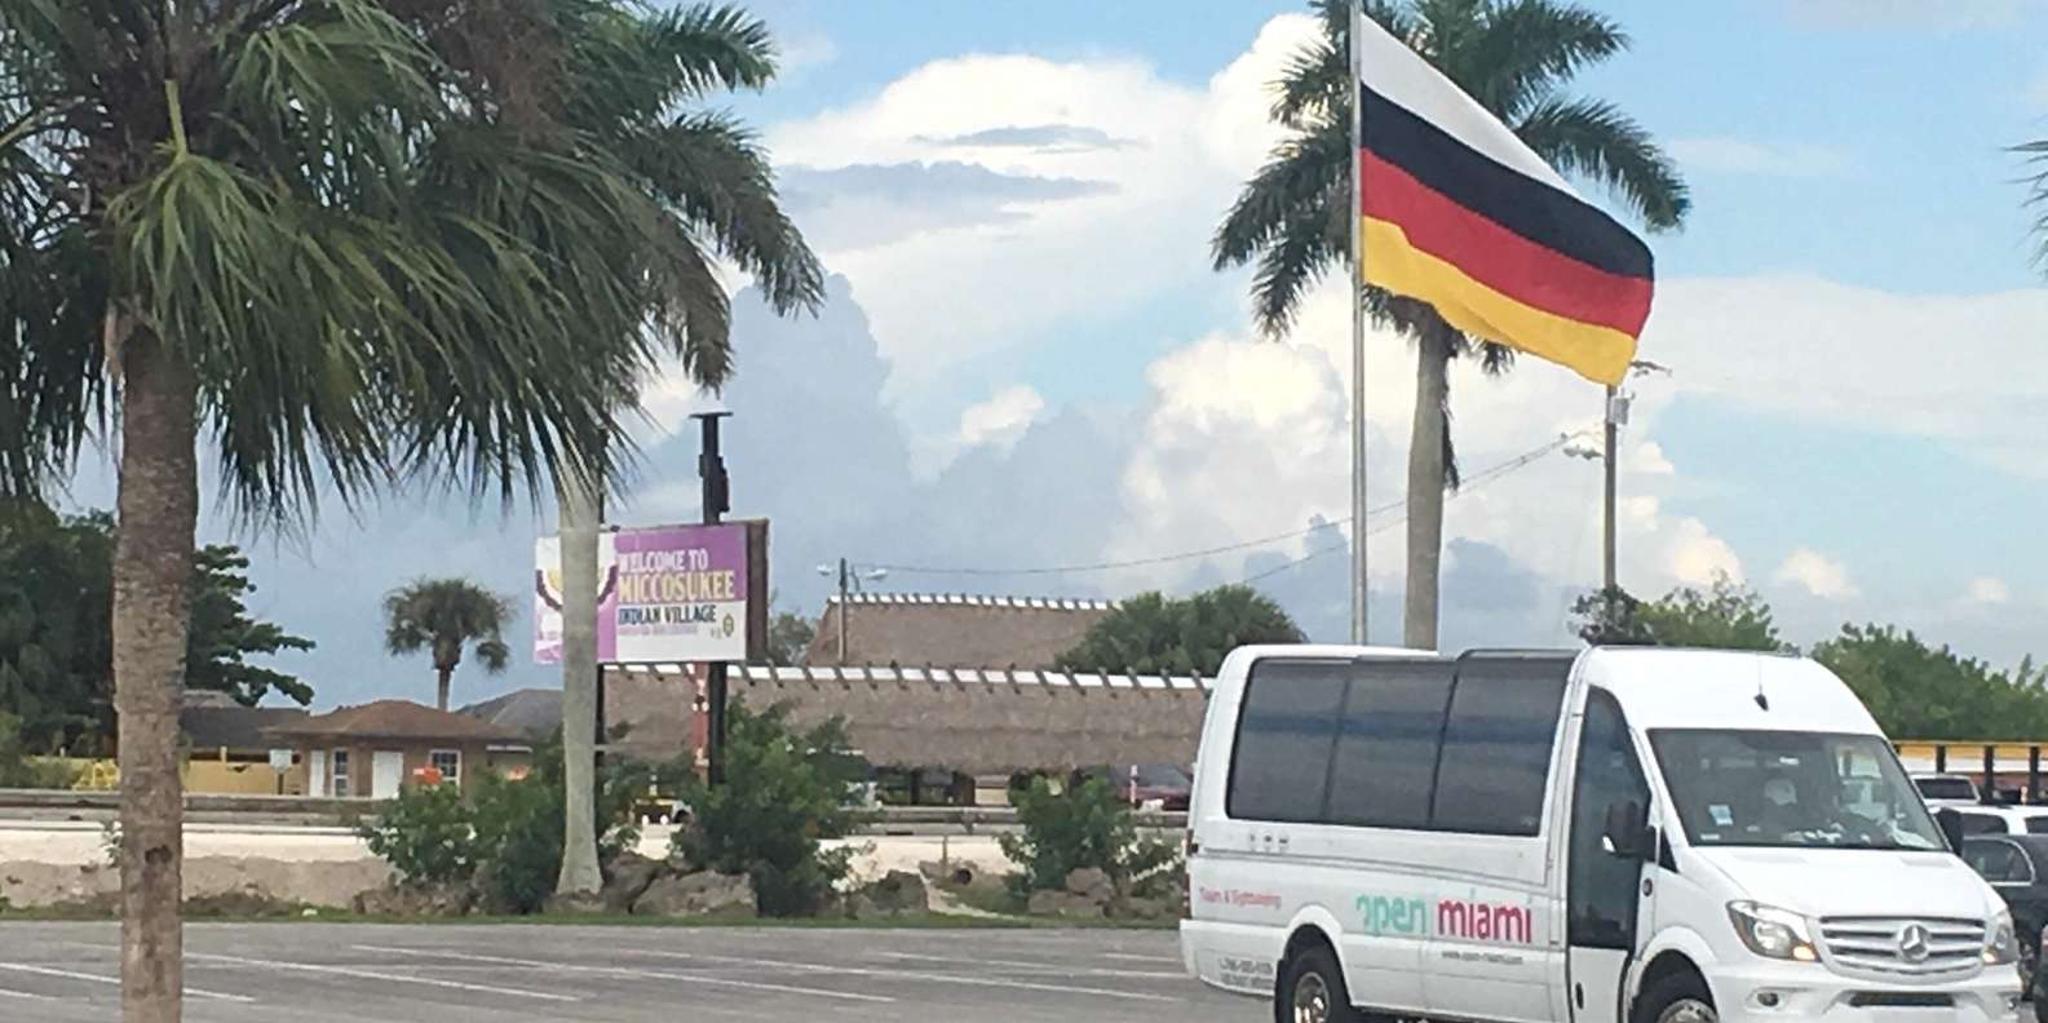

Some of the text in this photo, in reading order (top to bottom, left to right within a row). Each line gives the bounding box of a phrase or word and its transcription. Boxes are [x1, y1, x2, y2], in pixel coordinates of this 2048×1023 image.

[618, 548, 708, 572] WELCOME TO
[618, 570, 735, 602] MICCOSUKEE
[618, 604, 717, 625] INDIAN VILLAGE
[1438, 887, 1532, 943] miami
